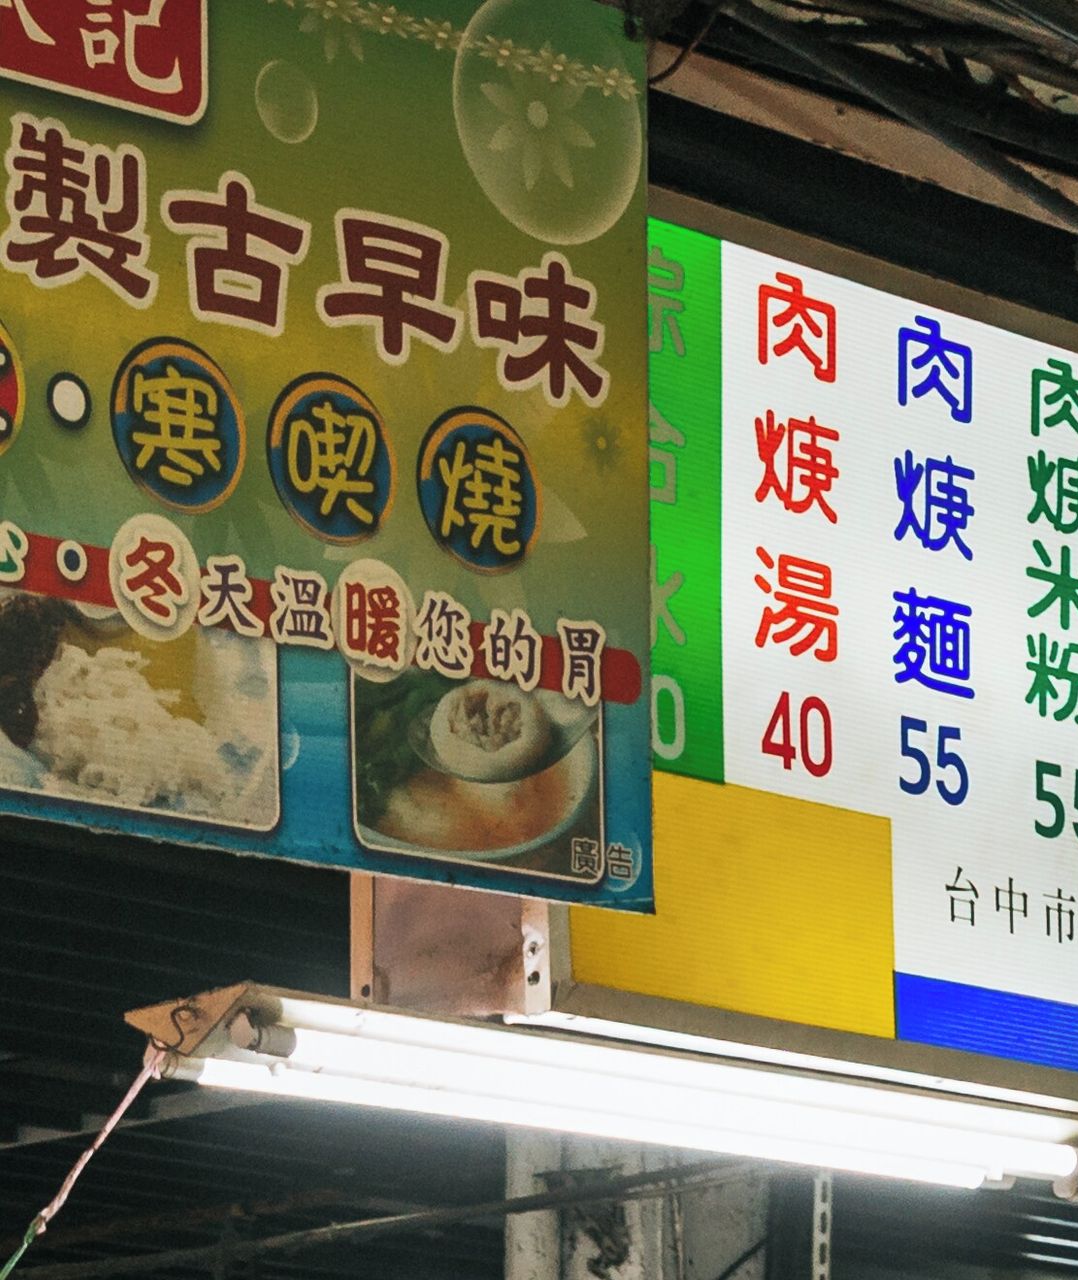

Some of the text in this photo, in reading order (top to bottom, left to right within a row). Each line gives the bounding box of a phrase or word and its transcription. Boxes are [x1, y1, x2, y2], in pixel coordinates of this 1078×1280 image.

[0, 0, 184, 94] 記
[6, 120, 606, 400] 製古早味
[125, 536, 602, 702] 冬天溫暖您的胃
[762, 691, 832, 777] 40
[900, 715, 968, 805] 55
